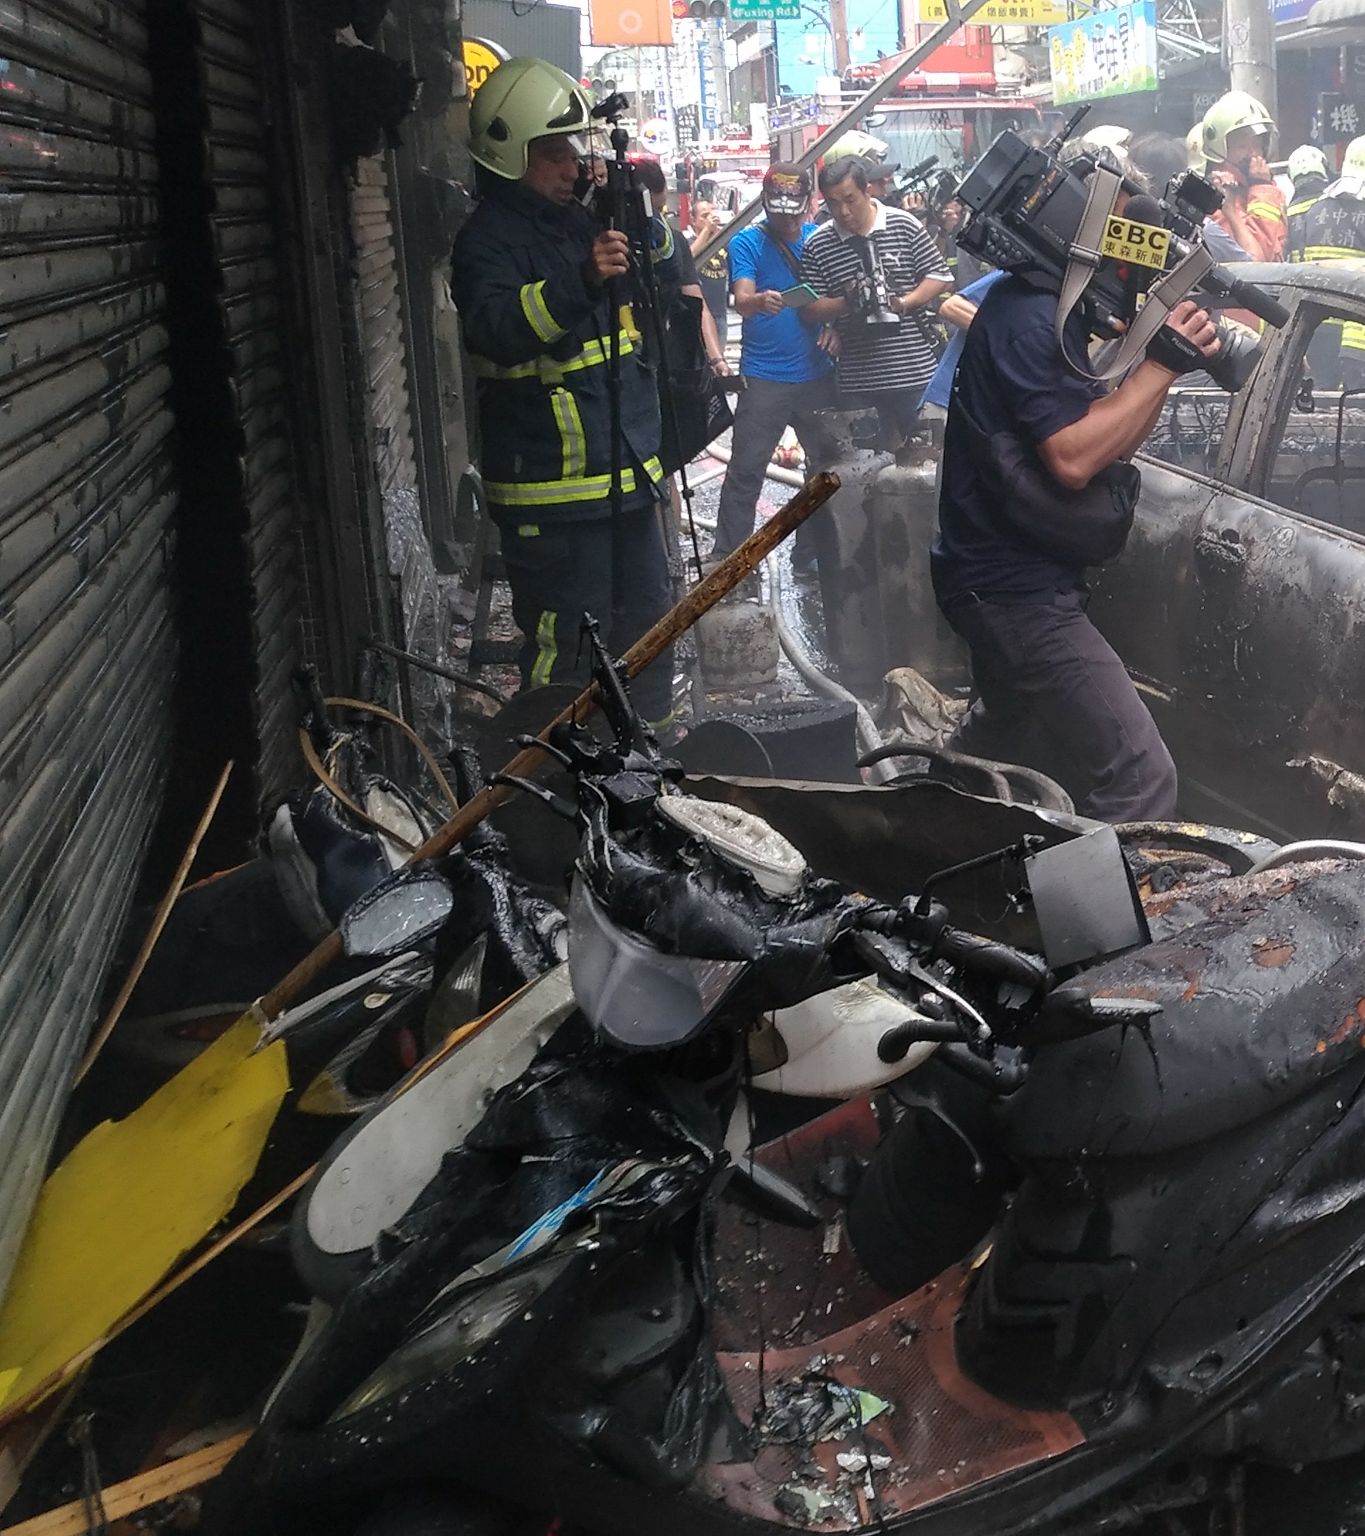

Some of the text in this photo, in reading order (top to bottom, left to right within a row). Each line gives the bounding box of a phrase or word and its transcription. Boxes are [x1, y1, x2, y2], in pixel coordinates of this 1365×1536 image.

[738, 7, 774, 18] Fuxing
[1103, 240, 1164, 267] 東森新聞
